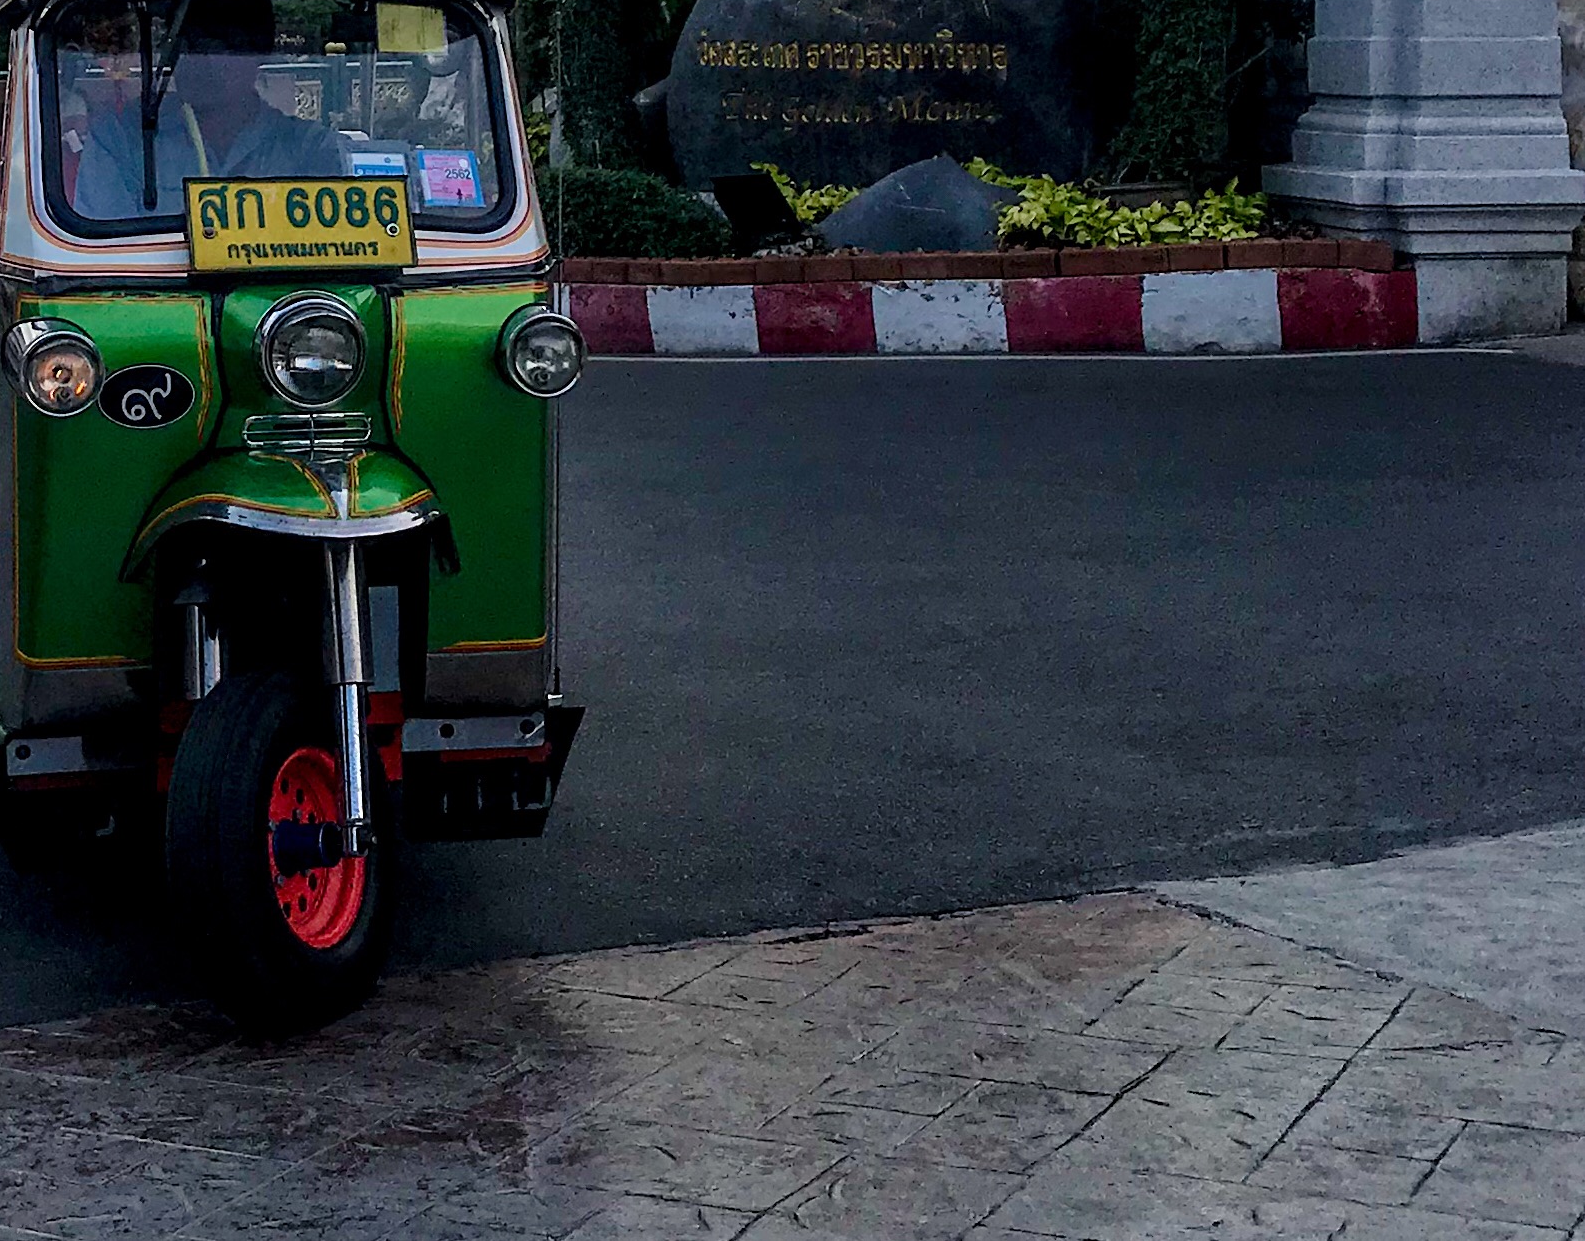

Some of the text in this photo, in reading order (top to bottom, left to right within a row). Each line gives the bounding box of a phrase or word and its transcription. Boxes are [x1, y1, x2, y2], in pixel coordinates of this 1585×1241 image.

[444, 168, 472, 180] 2562
[198, 185, 265, 230] สก
[286, 186, 399, 228] 6086
[227, 240, 379, 264] กรุงเทพมหานคร
[121, 372, 172, 421] ๙
